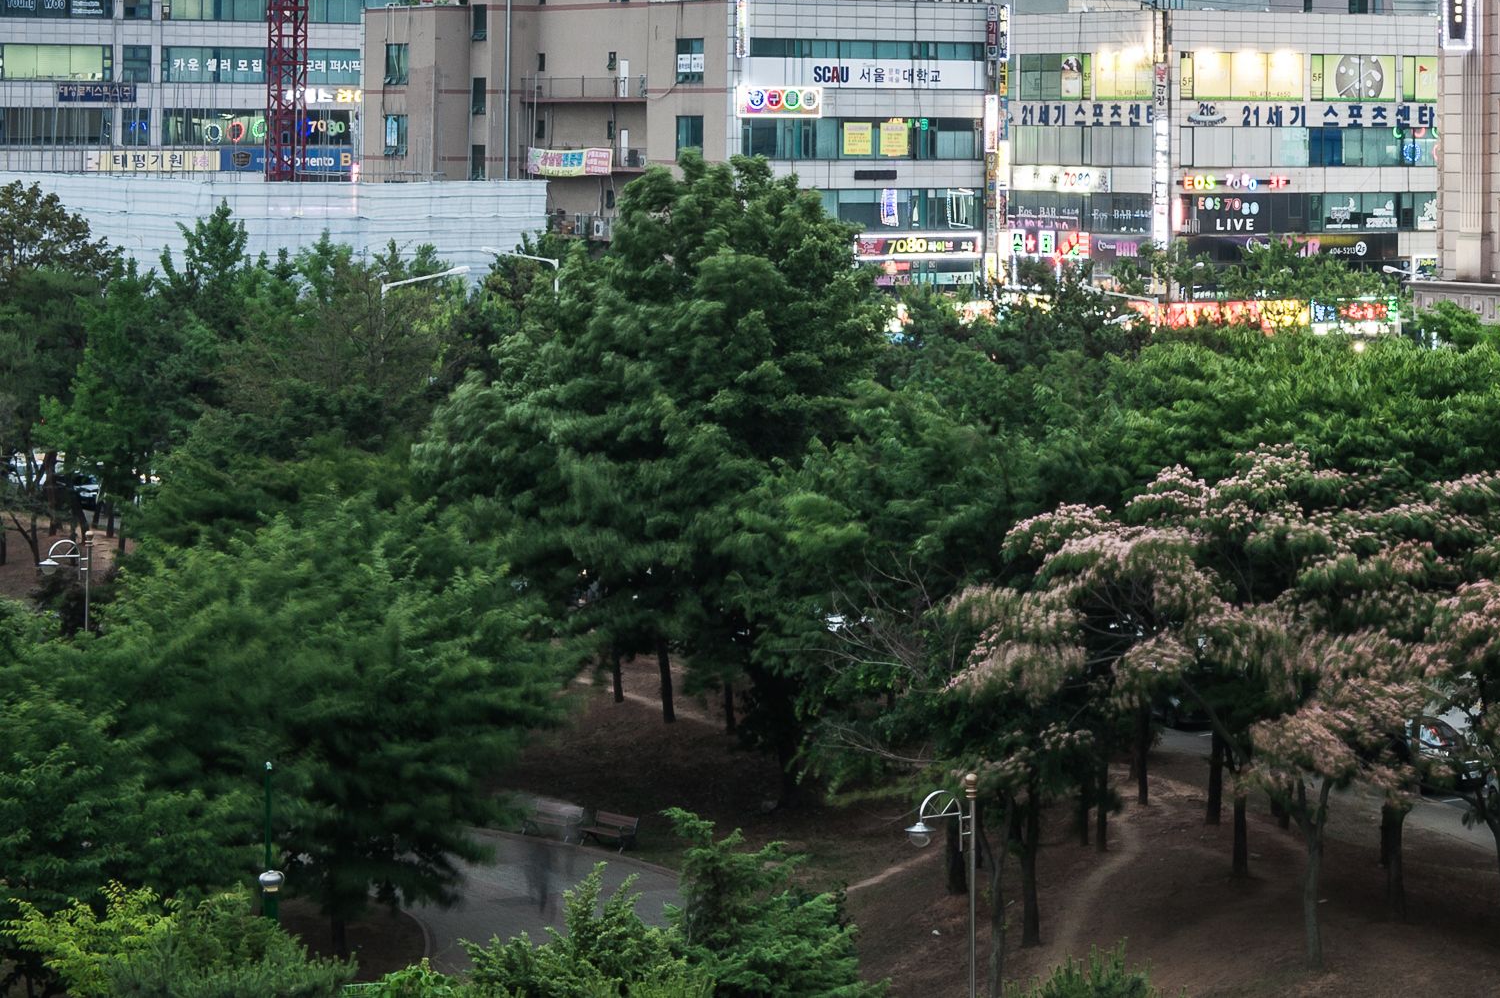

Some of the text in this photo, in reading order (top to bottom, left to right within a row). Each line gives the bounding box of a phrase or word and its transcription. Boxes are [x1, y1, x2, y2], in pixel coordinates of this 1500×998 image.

[813, 66, 850, 83] SCAU
[859, 67, 942, 83] 서울 대학교
[1312, 72, 1322, 82] 5F
[1021, 104, 1066, 127] 21세기
[1242, 104, 1436, 129] 21세기 스포츠센타
[112, 153, 183, 169] 태평기원
[1064, 170, 1091, 187] 7080
[1183, 175, 1216, 190] EOS
[1225, 174, 1258, 191] 7080
[1039, 206, 1057, 217] BAR
[1198, 196, 1260, 215] EOS 7080
[1215, 218, 1255, 231] LIVE
[887, 236, 928, 254] 7080
[1115, 241, 1138, 257] BAR
